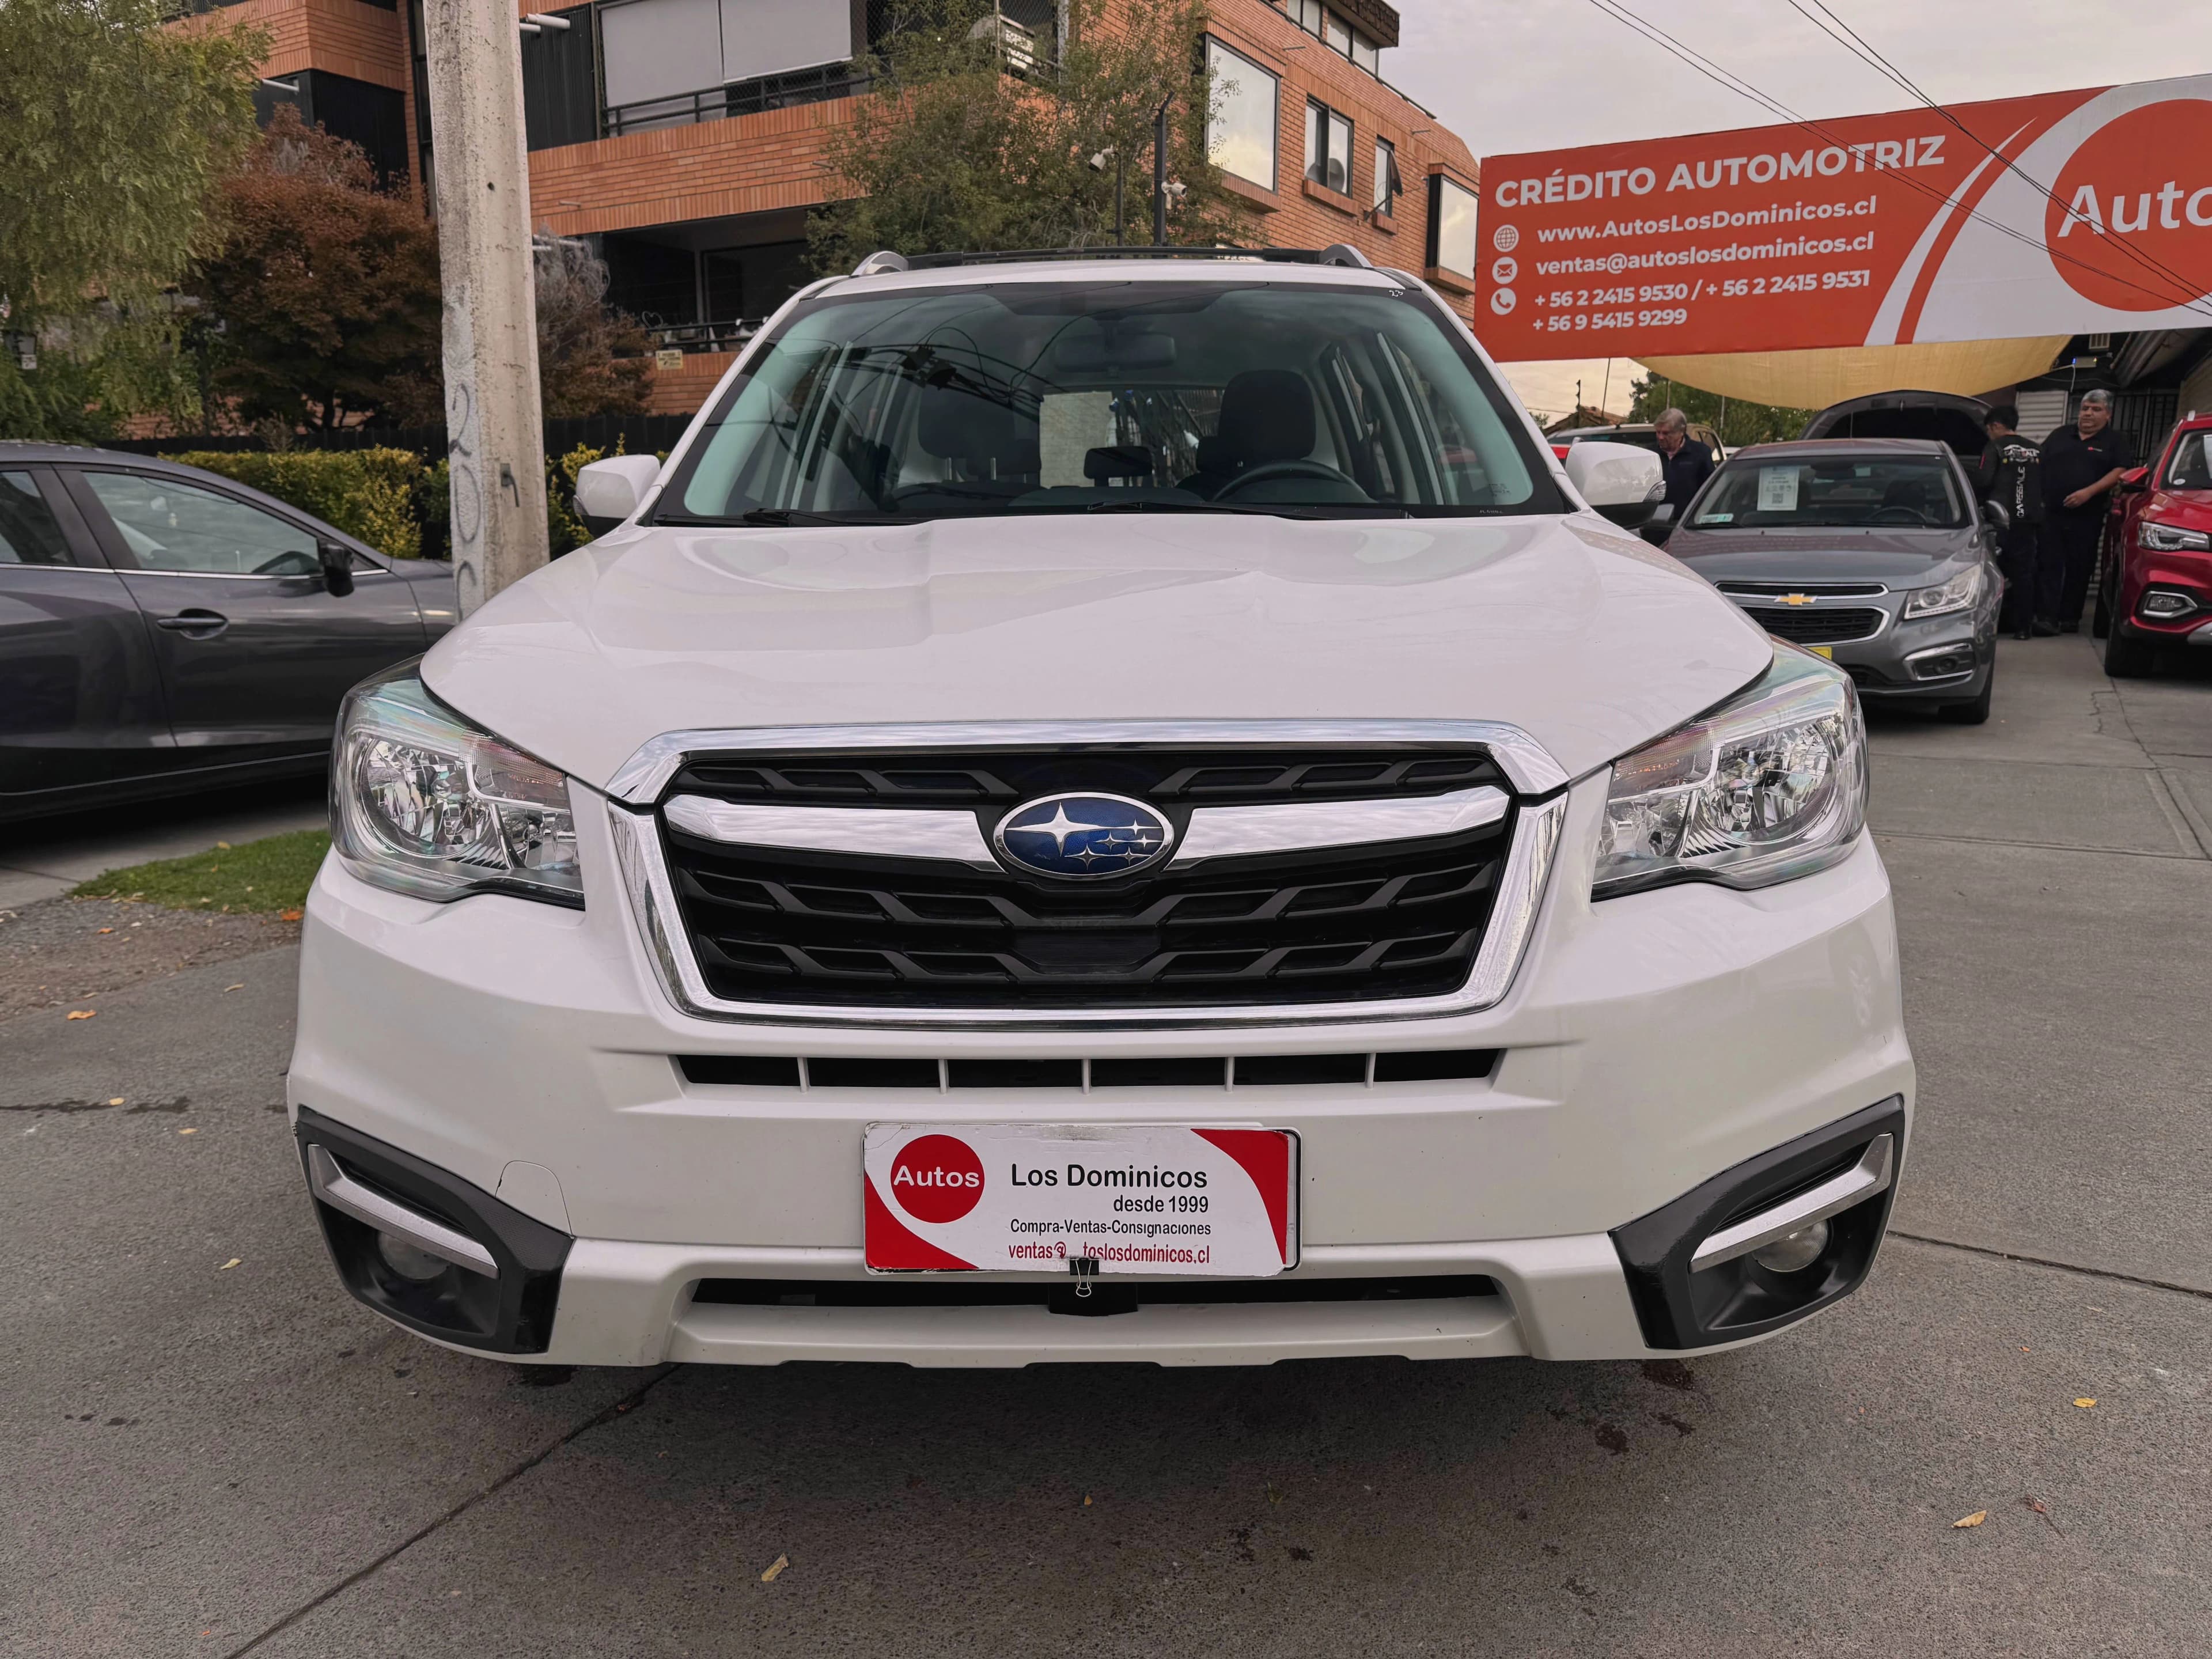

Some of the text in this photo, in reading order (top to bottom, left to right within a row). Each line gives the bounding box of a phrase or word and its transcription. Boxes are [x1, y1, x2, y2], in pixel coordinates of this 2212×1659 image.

[1495, 135, 1946, 209] CRÉDITO AUTOMOTRIZ
[1537, 195, 1877, 243] www.AutosLosDominicos.cl
[1536, 230, 1874, 275] ventas@autoslosdominicos.cl
[1535, 269, 1870, 308] + 56 2 2415 9530 / + 56 2 2415 9531
[1532, 308, 1687, 332] + 56 9 5415 9299
[893, 1165, 979, 1188] Autos
[1012, 1163, 1208, 1188] Los Dominicos
[1113, 1195, 1209, 1213] desde 1999
[1010, 1218, 1211, 1238] Compra-Ventas-Consignaciones
[1009, 1241, 1210, 1264] ventas@toslosdominicos.cl
